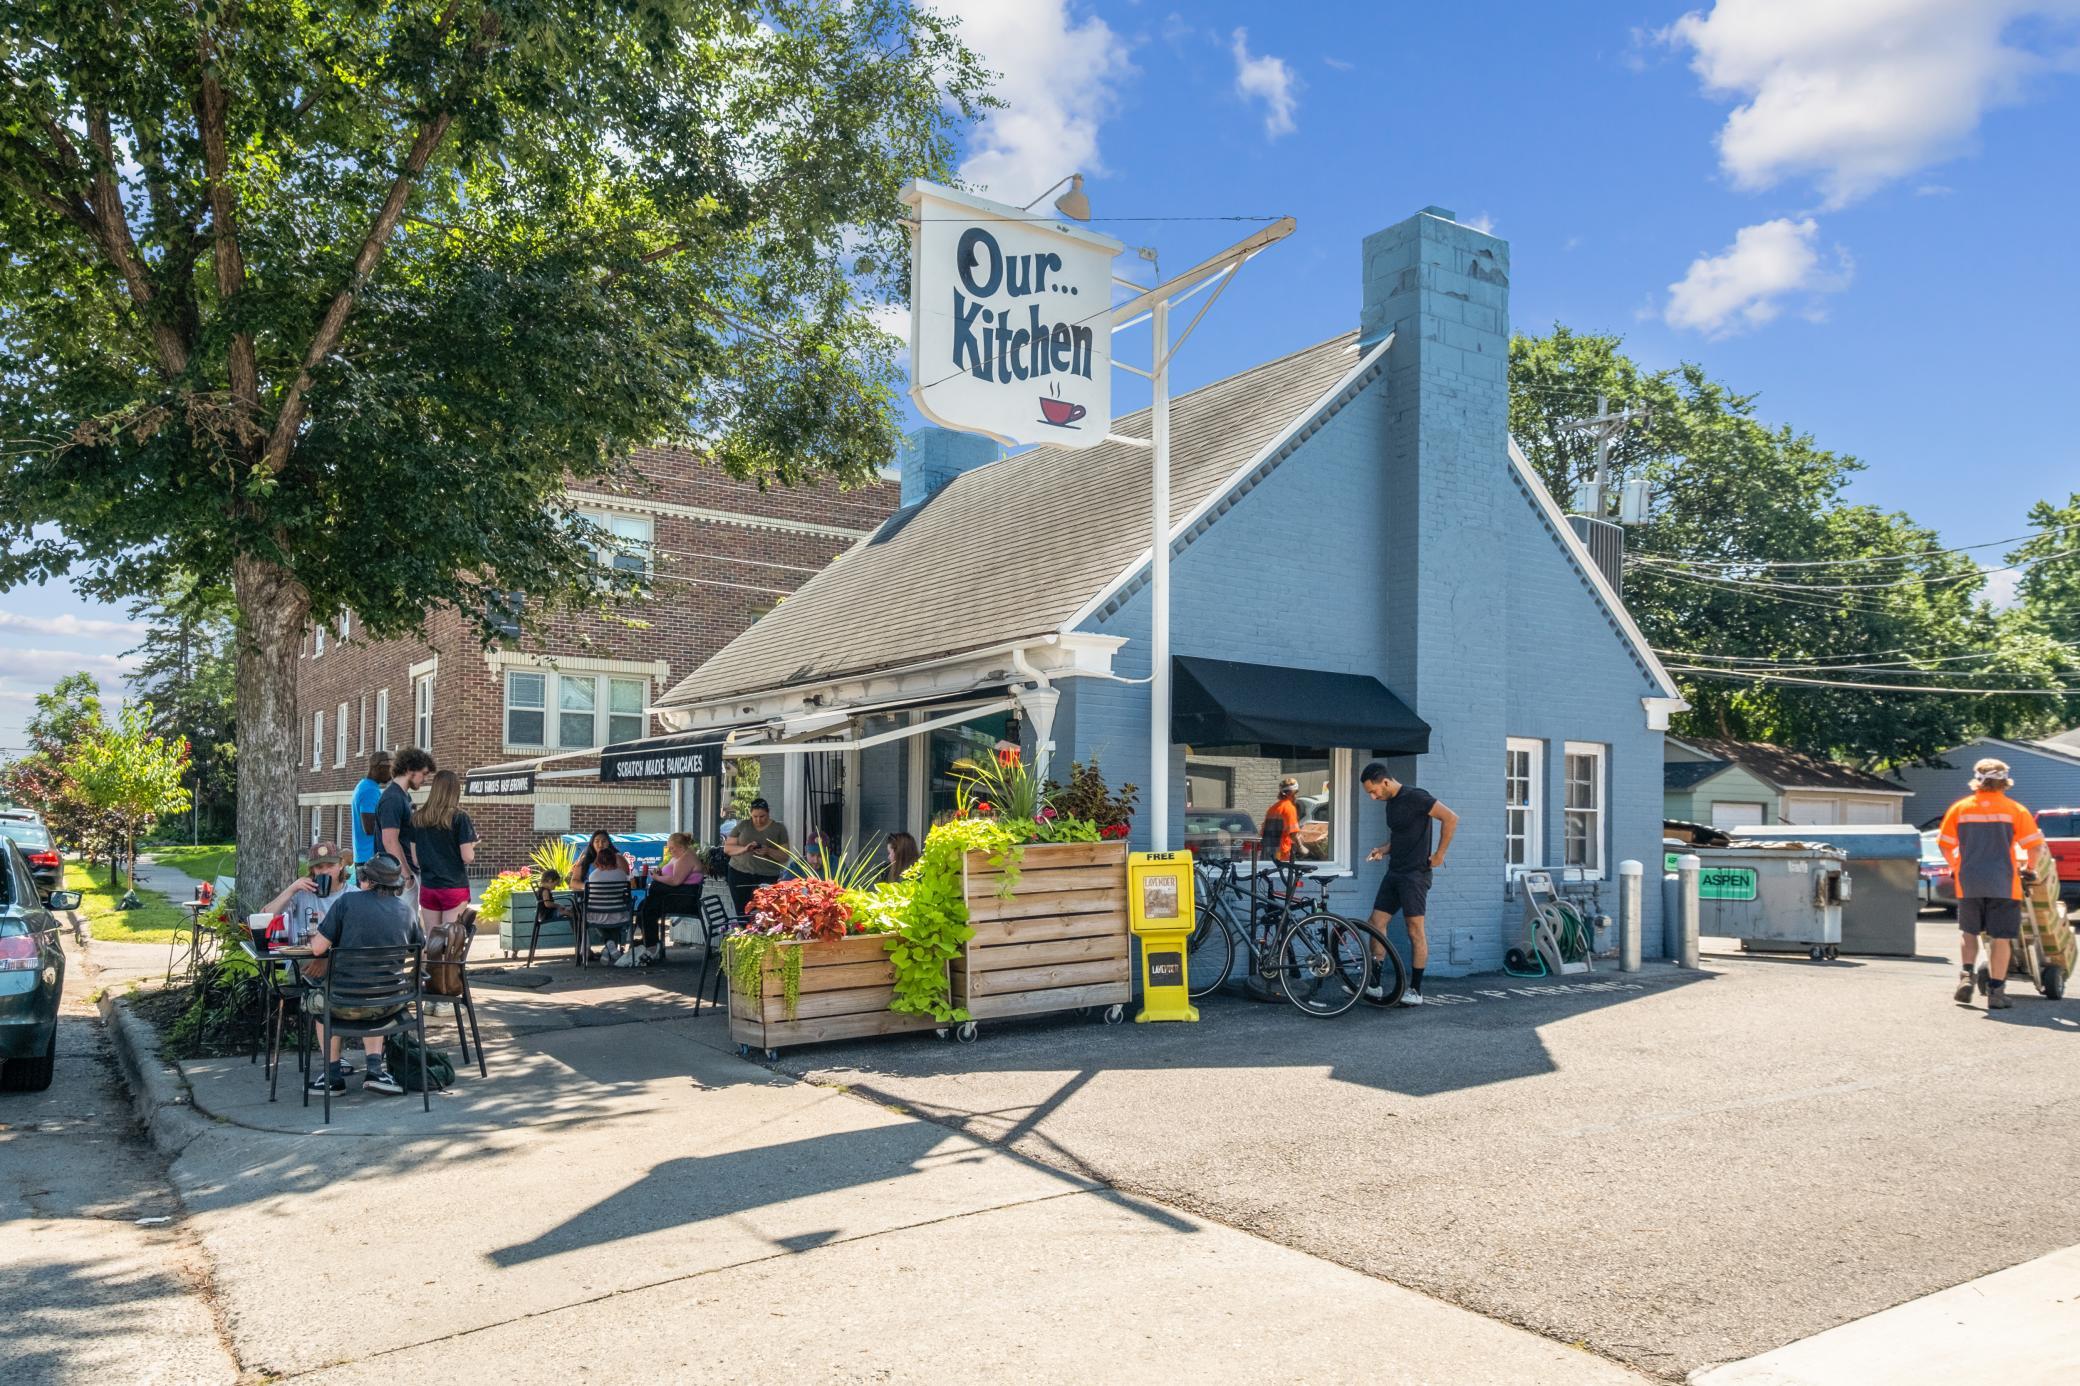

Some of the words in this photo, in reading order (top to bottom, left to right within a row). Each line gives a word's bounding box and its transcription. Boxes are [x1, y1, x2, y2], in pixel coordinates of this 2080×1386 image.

[957, 227, 1078, 298] Our...
[953, 286, 1093, 384] Kitchen
[617, 761, 644, 777] SCRATCH
[644, 759, 665, 776] MADE
[666, 755, 702, 774] PANCAKES
[1702, 875, 1750, 886] ASPEN
